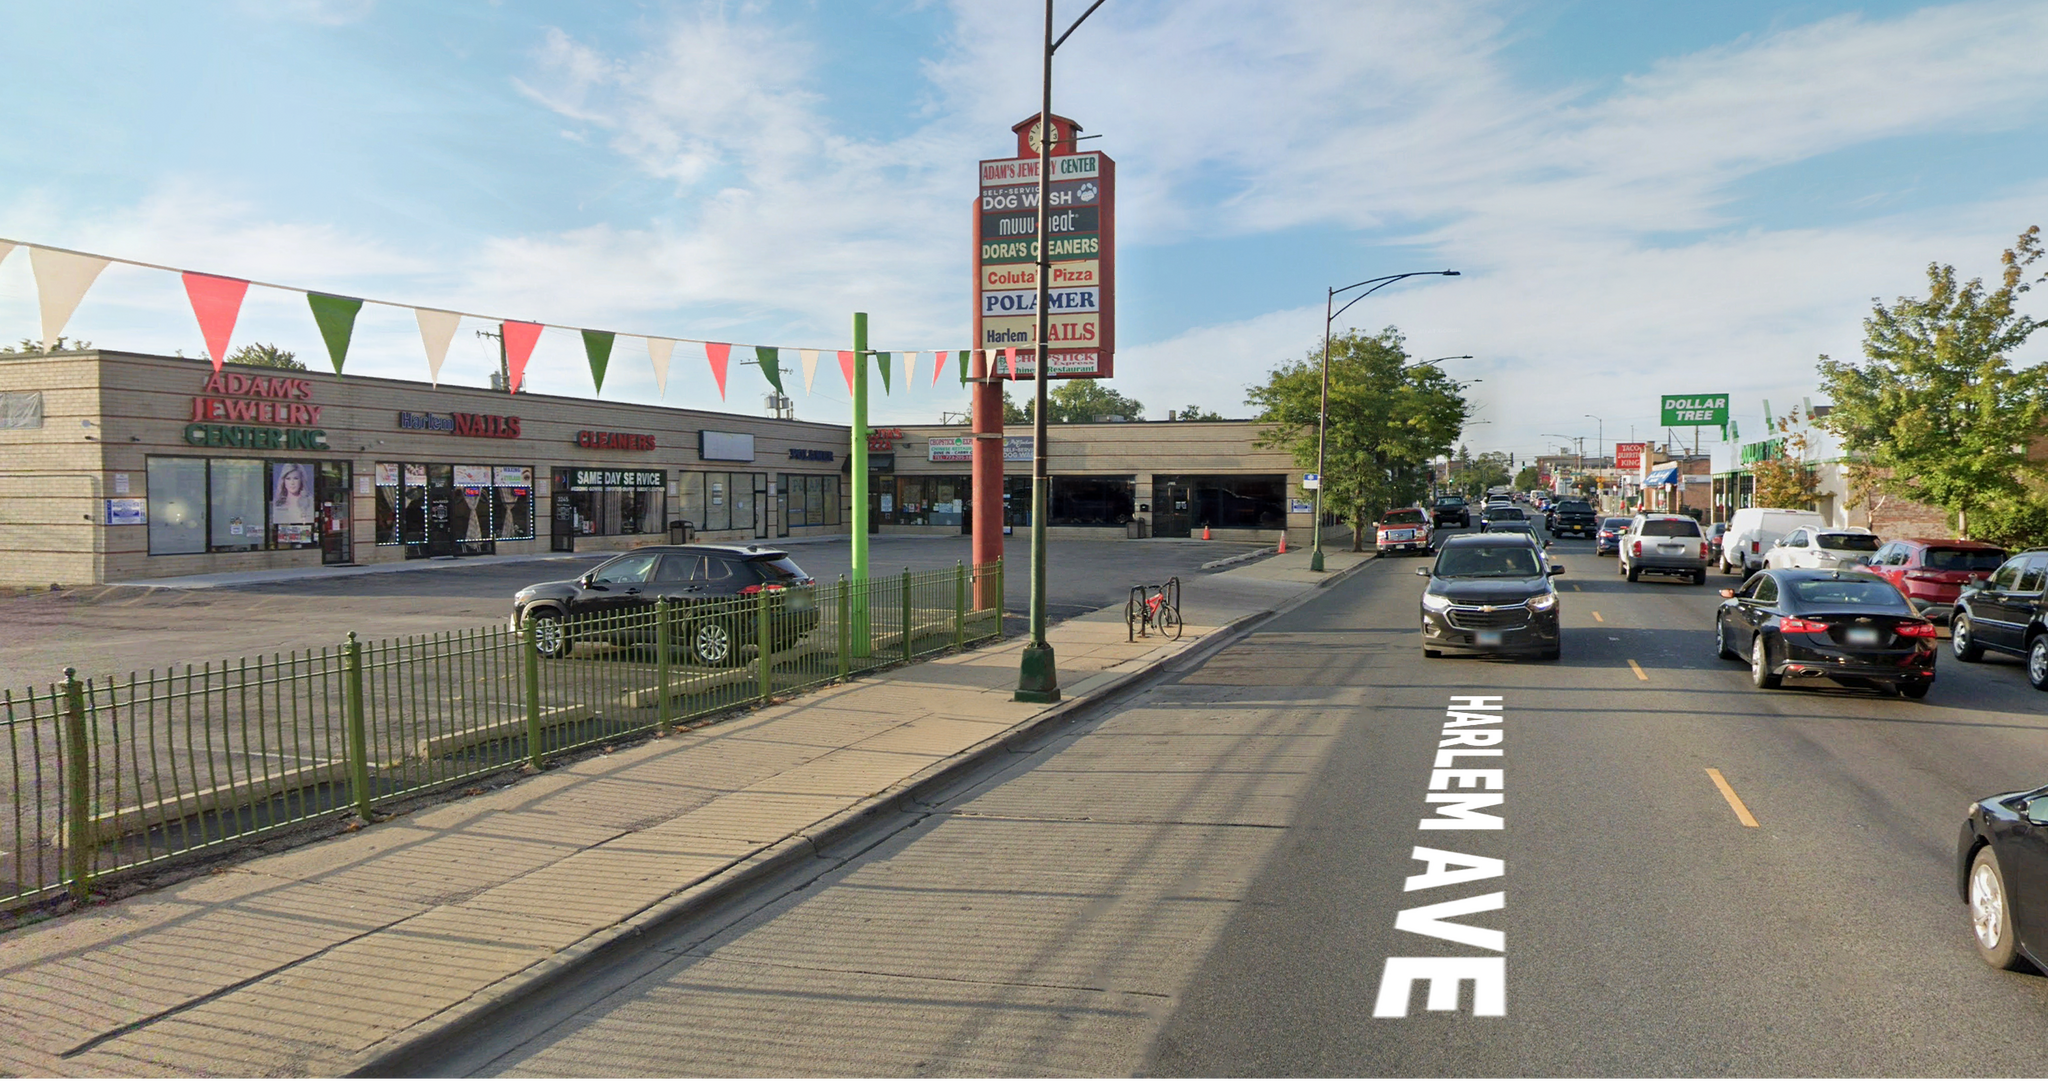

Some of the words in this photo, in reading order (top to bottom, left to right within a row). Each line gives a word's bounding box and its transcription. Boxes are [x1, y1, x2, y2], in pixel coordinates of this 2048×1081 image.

[982, 164, 1016, 180] ADAM'S
[1017, 160, 1057, 178] JEWEY
[1061, 156, 1096, 174] CENTER
[983, 186, 1040, 196] SELF-SERVIC
[983, 195, 1018, 210] DOG
[1022, 191, 1072, 207] WSH
[982, 242, 1027, 259] DORA'S
[1030, 238, 1098, 256] CEANERS
[1054, 268, 1093, 282] Pizza
[987, 328, 1028, 342] Harlem
[206, 372, 312, 400] ADAM'S
[193, 396, 322, 424] JEWELRY
[1665, 398, 1726, 410] DOLLAR
[1676, 410, 1714, 420] TREE
[400, 411, 454, 430] Harlem
[452, 412, 521, 439] NAILS
[185, 423, 282, 449] CENTER
[577, 430, 656, 450] CLEANERS
[577, 470, 602, 484] SAME
[604, 472, 622, 484] DAY
